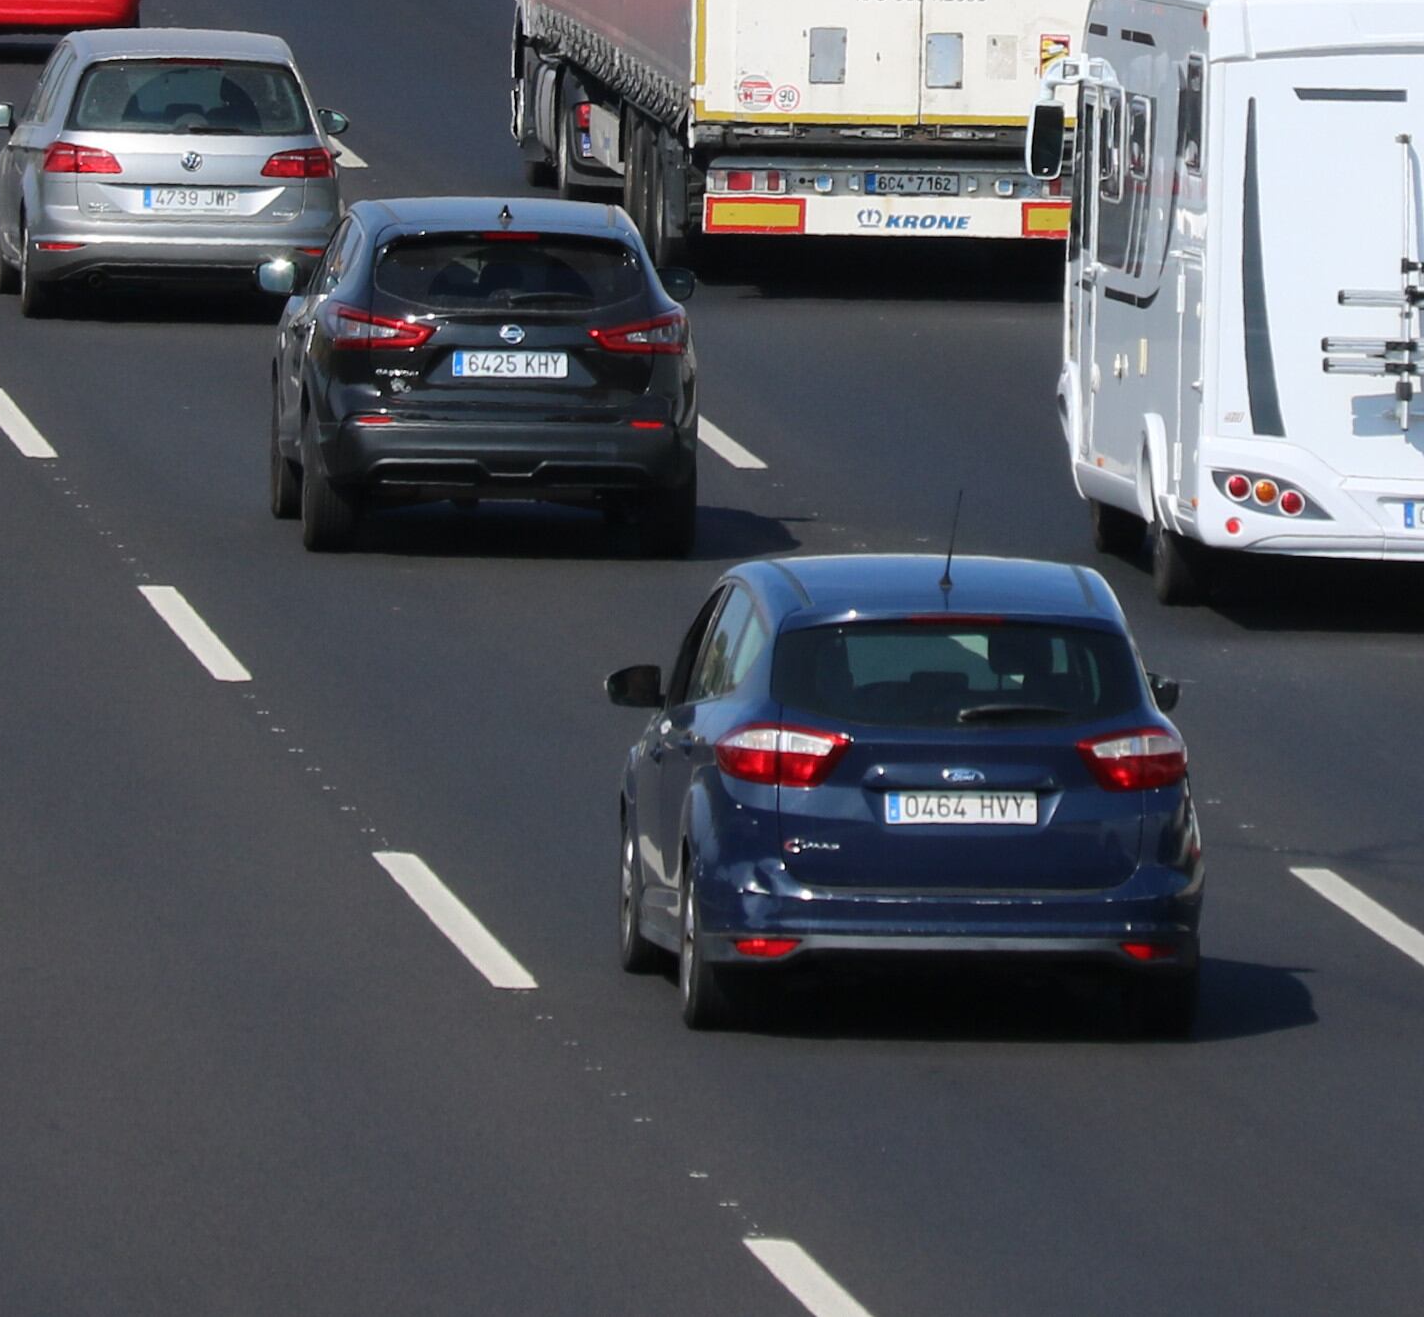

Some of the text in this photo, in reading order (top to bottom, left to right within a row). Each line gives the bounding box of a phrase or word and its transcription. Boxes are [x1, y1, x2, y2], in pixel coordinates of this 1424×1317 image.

[779, 90, 795, 103] 90
[917, 175, 952, 192] 7162
[155, 191, 236, 207] 4739 JWP
[885, 214, 972, 231] KRONE
[468, 354, 561, 374] 6425 KHY
[904, 795, 1025, 818] 0464 HVY
